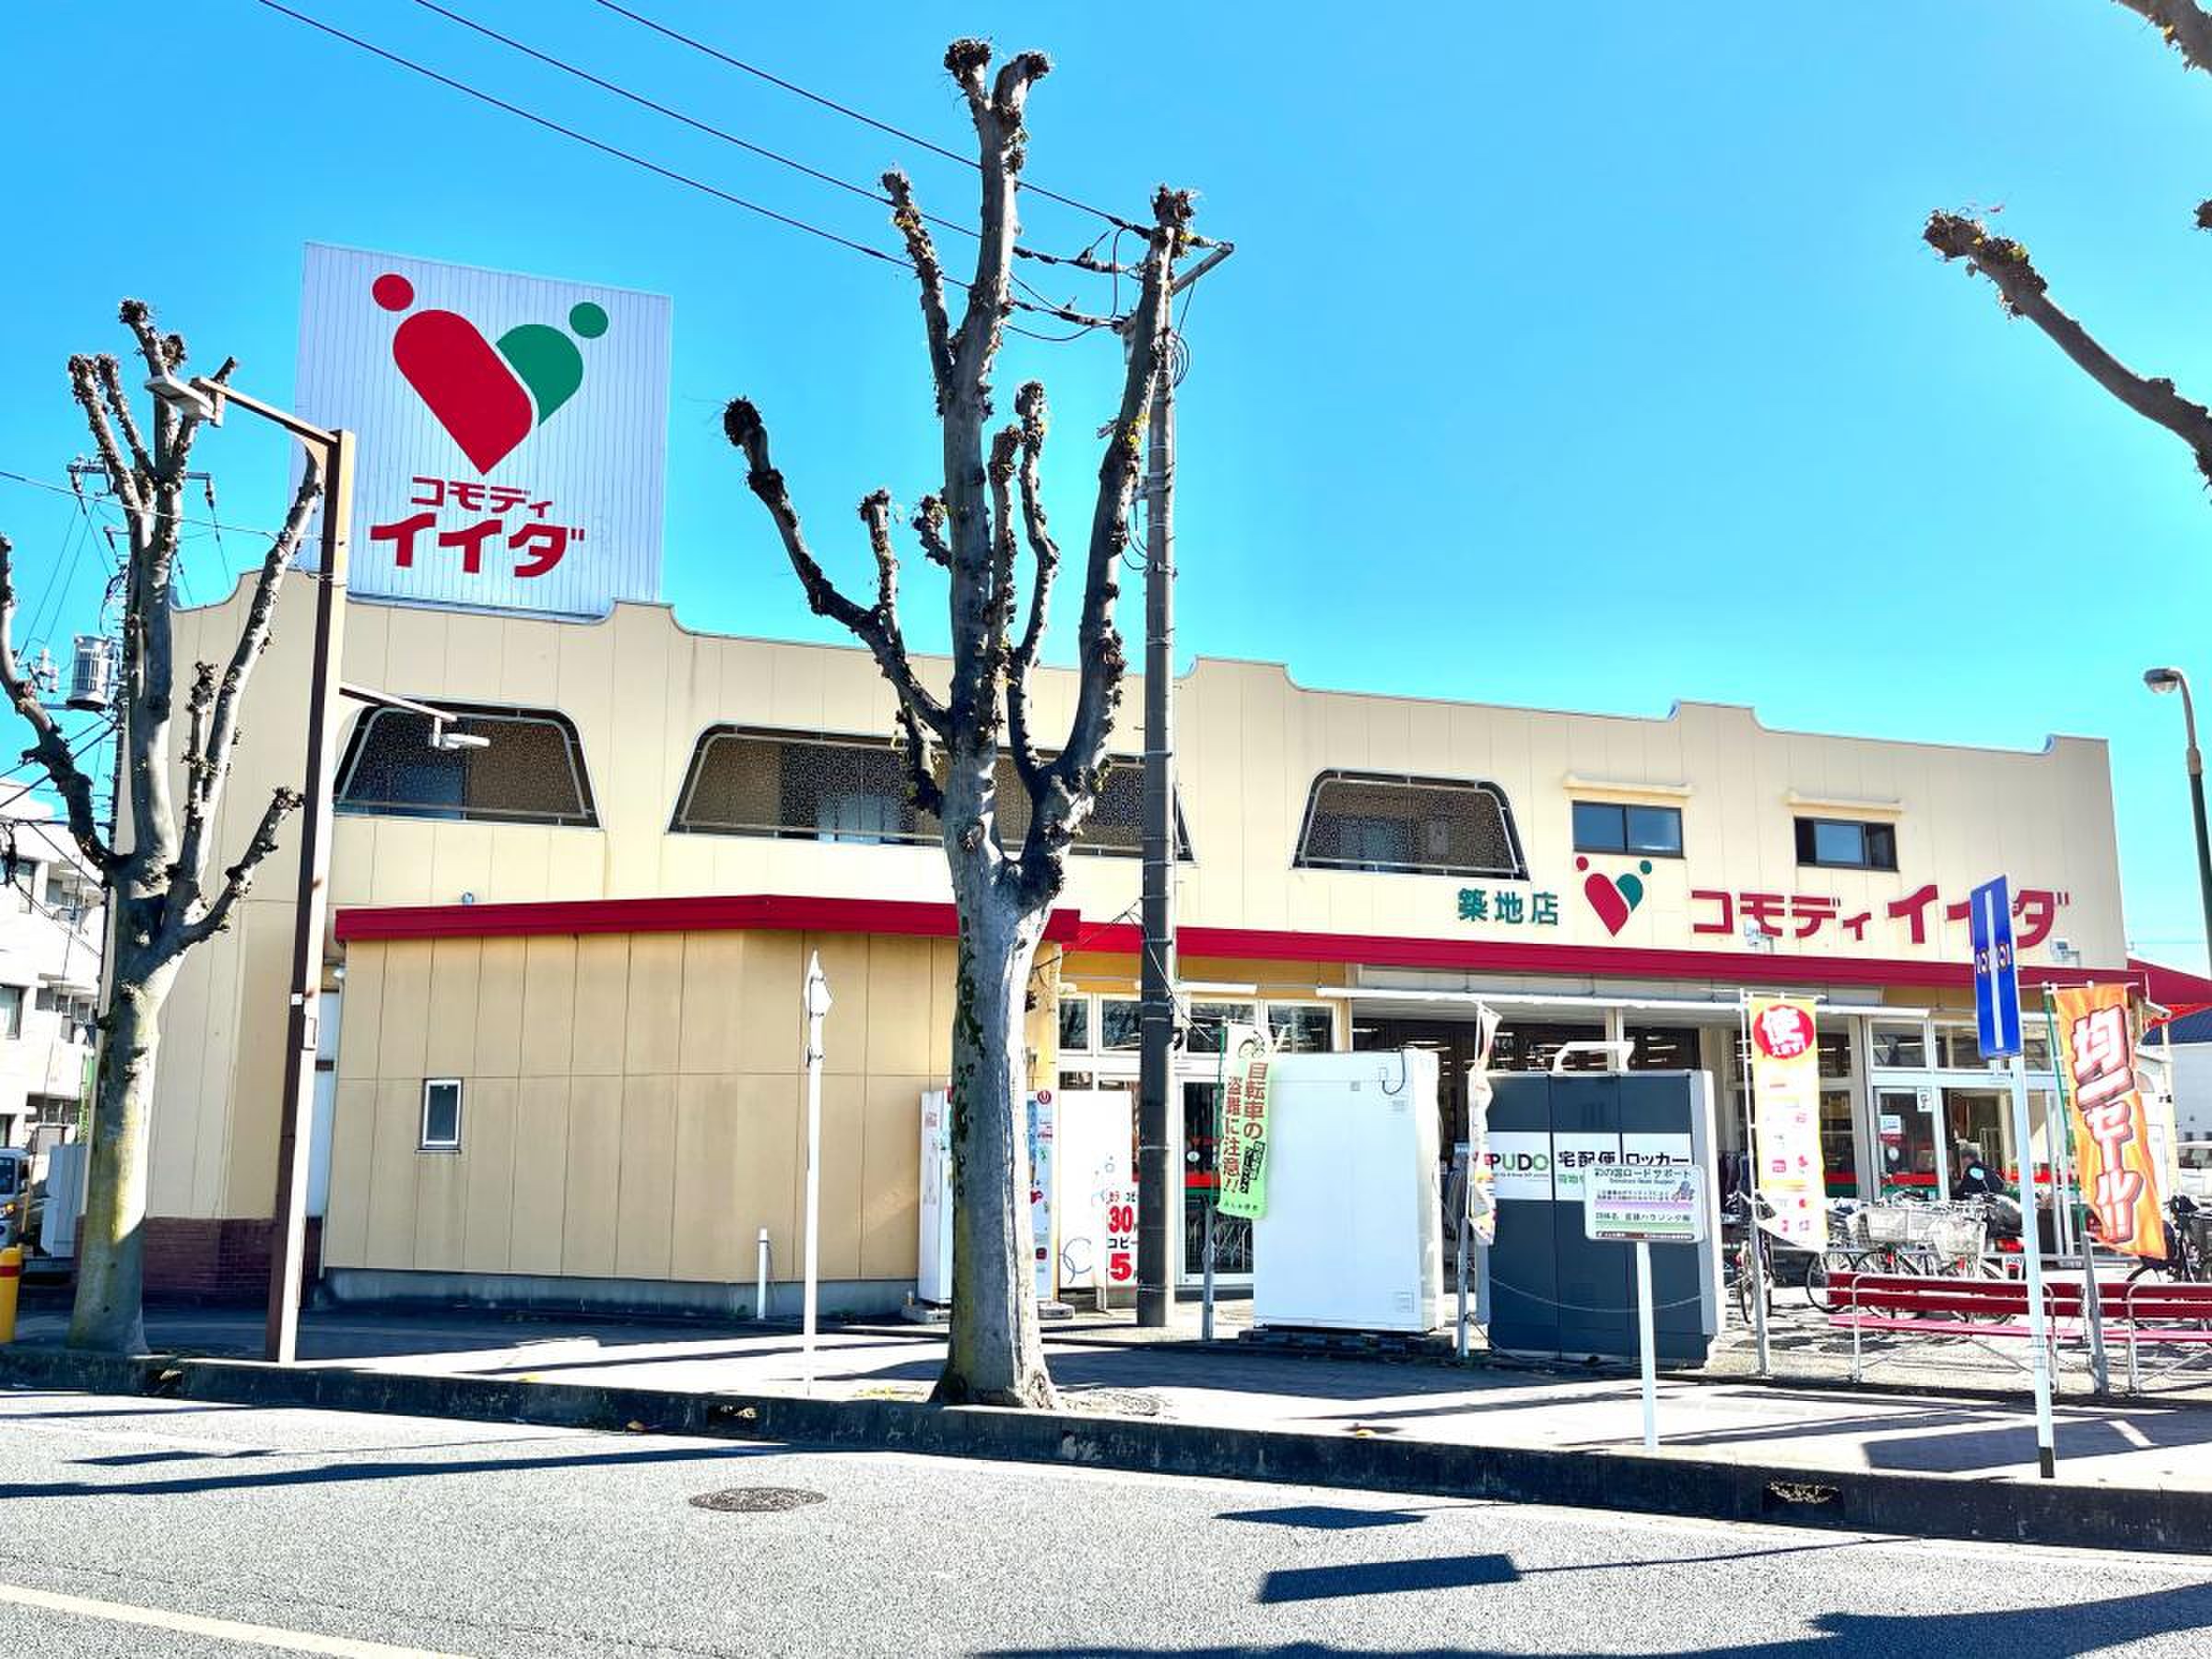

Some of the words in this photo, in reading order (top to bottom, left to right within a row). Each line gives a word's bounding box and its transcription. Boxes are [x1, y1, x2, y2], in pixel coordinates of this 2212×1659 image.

[411, 476, 553, 518] コモディ
[370, 512, 584, 578] イイダ
[1456, 887, 1559, 926] 築地店
[1690, 889, 1872, 942] コモディ
[1244, 1061, 1269, 1141] 自転車の
[1490, 1153, 1549, 1171] PUDO
[1109, 1205, 1137, 1234] 30
